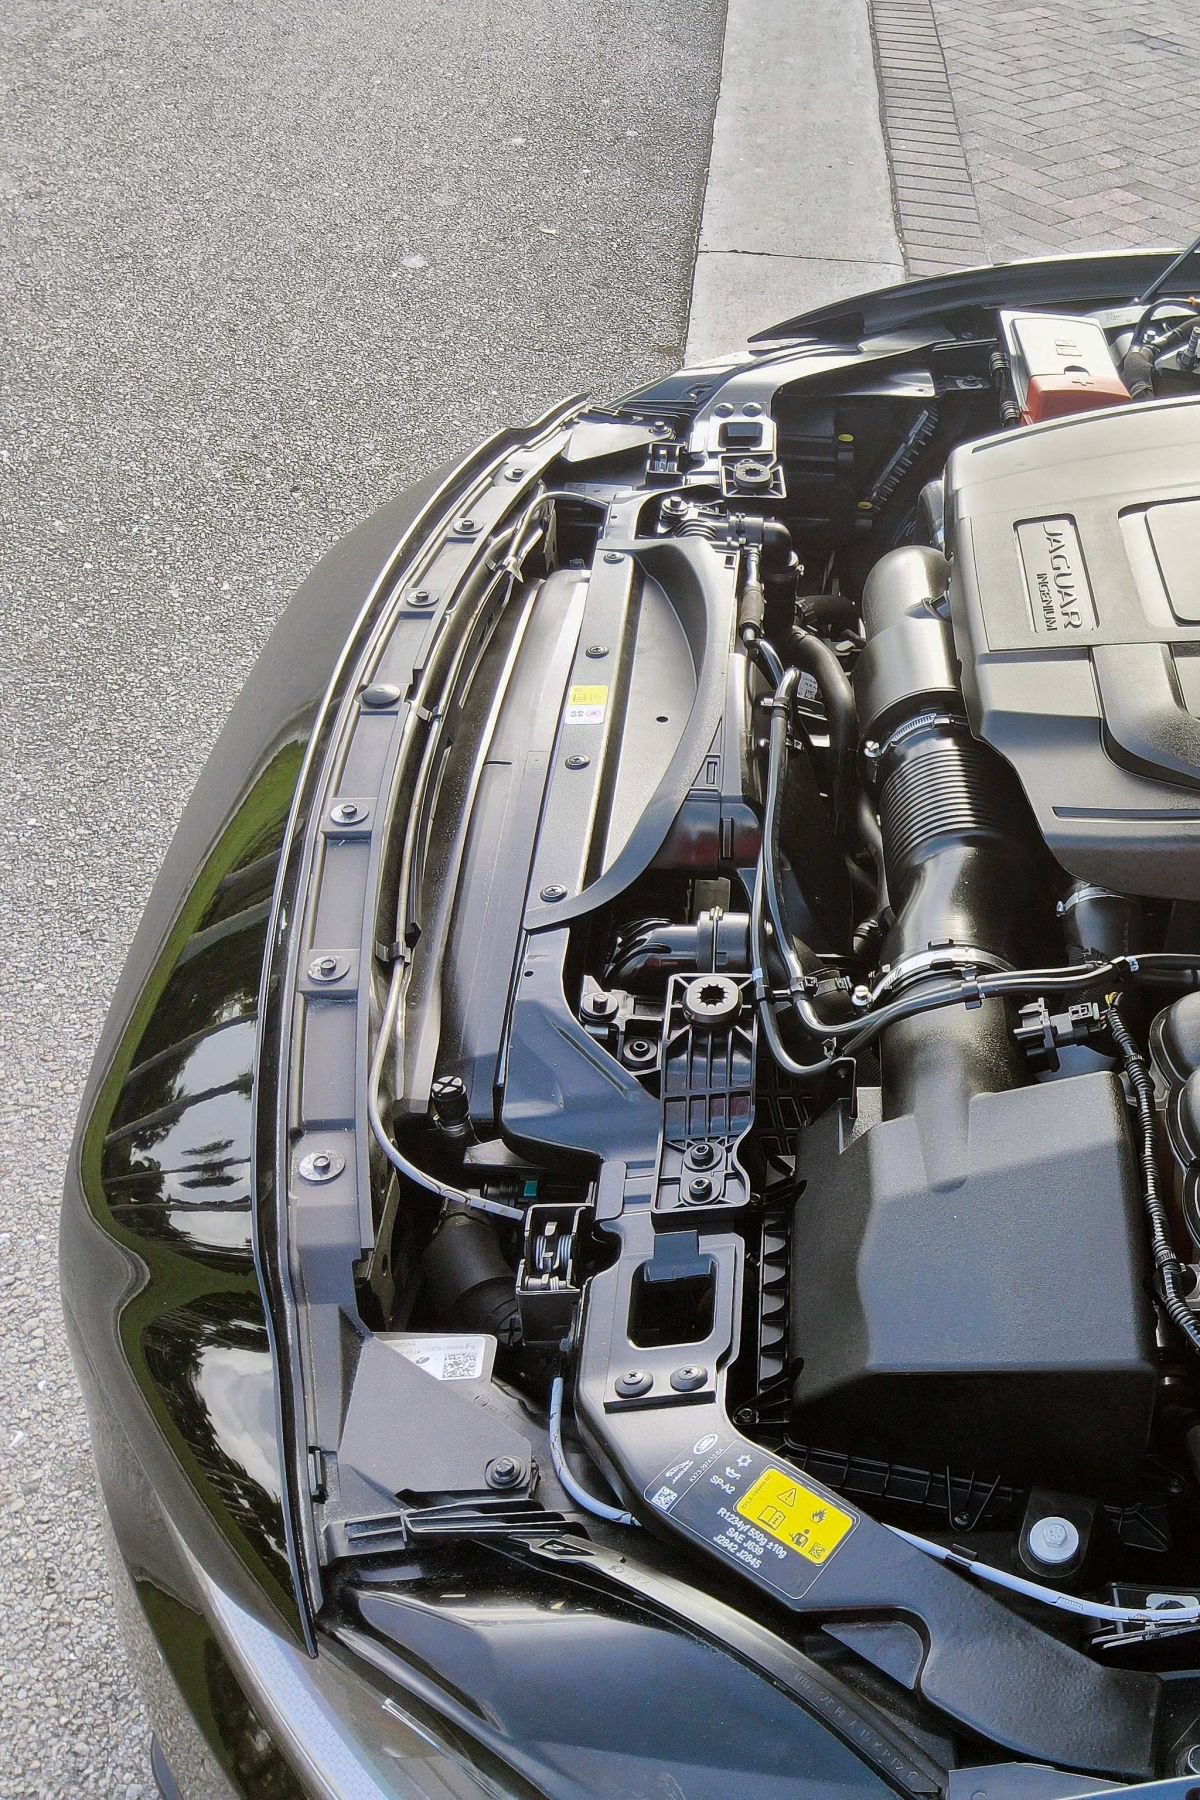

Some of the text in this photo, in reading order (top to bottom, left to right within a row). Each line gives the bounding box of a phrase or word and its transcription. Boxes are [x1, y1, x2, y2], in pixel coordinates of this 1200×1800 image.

[1042, 523, 1083, 630] JAGUAR
[1036, 573, 1058, 632] INGENIUM
[710, 1475, 736, 1495] SP-A2
[717, 1507, 751, 1533] R1234yf
[748, 1527, 768, 1546] 550g
[726, 1527, 764, 1556] SAE J639
[713, 1534, 762, 1568] J2842 J2845
